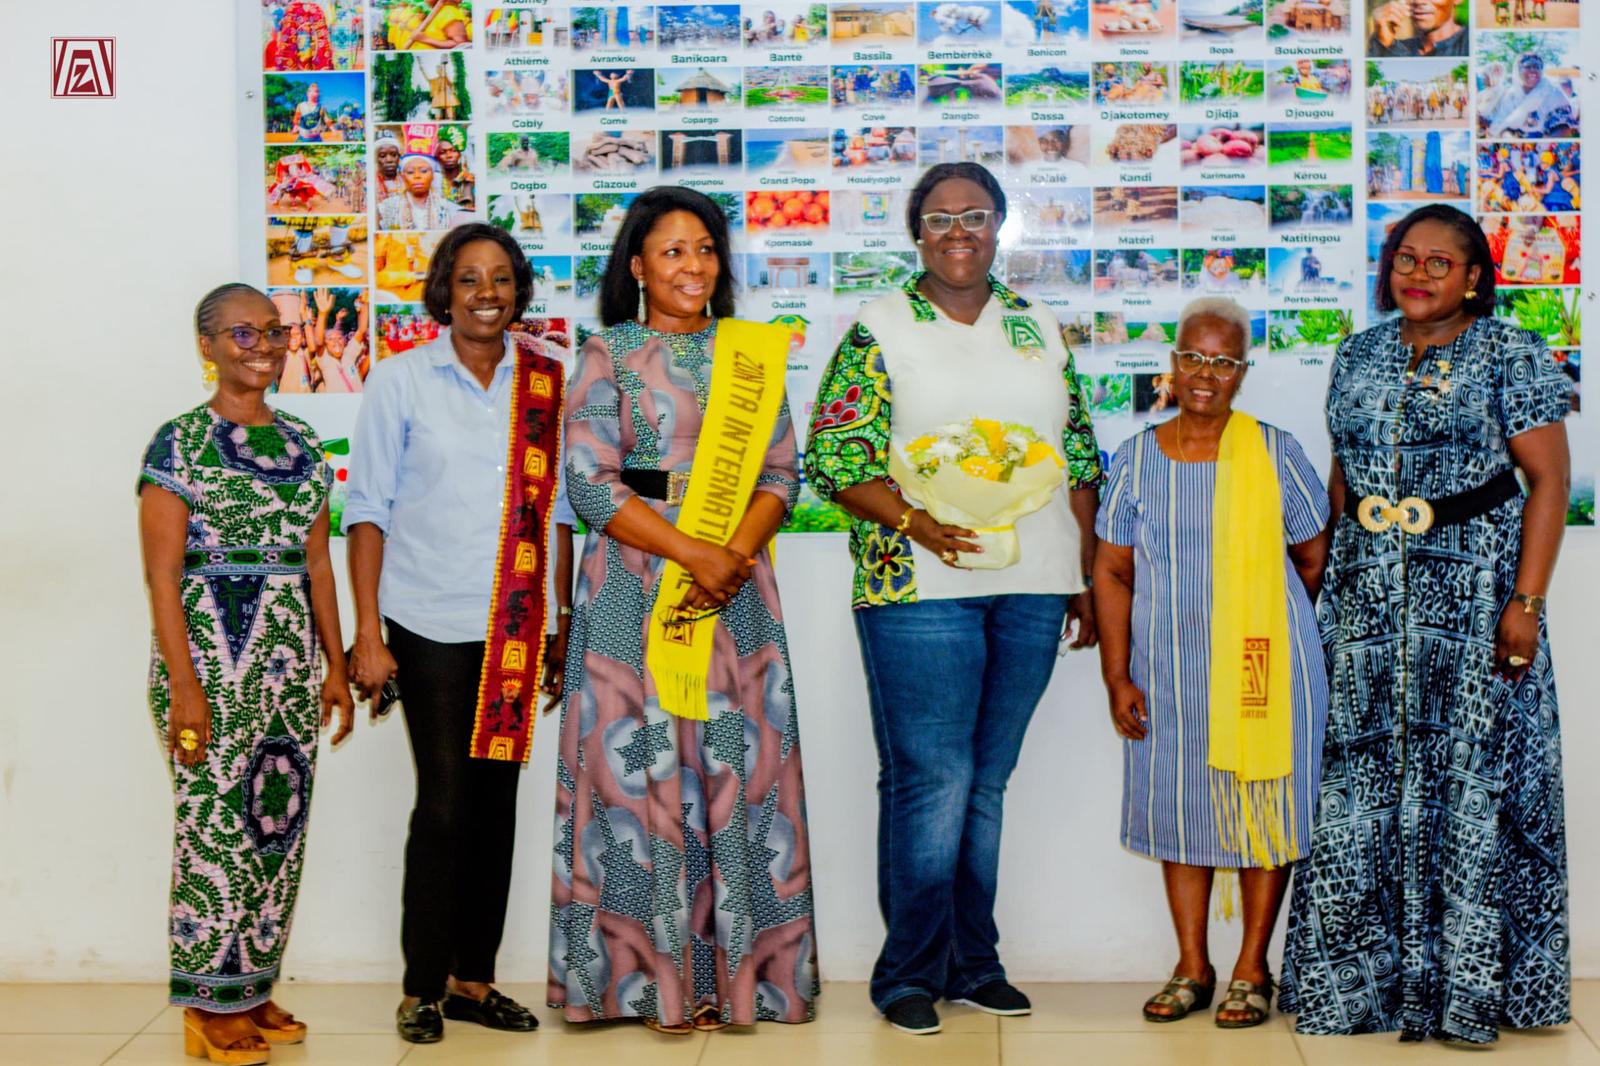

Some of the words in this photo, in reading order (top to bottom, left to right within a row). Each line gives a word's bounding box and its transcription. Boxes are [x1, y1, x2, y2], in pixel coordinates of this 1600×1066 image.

[1209, 46, 1234, 55] Bopa
[671, 55, 728, 64] Banikoara
[853, 51, 892, 61] Bassila
[942, 112, 980, 121] Dangbo
[1031, 112, 1065, 120] Dassa
[1101, 111, 1169, 121] Djakotomey
[1205, 110, 1239, 120] Djidja
[1285, 108, 1334, 119] Djougou
[512, 119, 543, 129] Cobly
[681, 117, 719, 125] Copargo
[759, 177, 789, 185] Grand
[791, 176, 816, 185] Popo
[1120, 172, 1152, 182] Kandi
[1200, 172, 1245, 180] Karimama
[510, 181, 547, 191] Dogbo
[863, 239, 887, 247] Lalo
[1280, 233, 1341, 244] Natitingou
[1284, 295, 1338, 303] Porto-Novo
[772, 301, 806, 309] Ouidah
[1299, 358, 1324, 366] Toffo
[787, 363, 809, 371] bana
[729, 350, 766, 414] ZONTA
